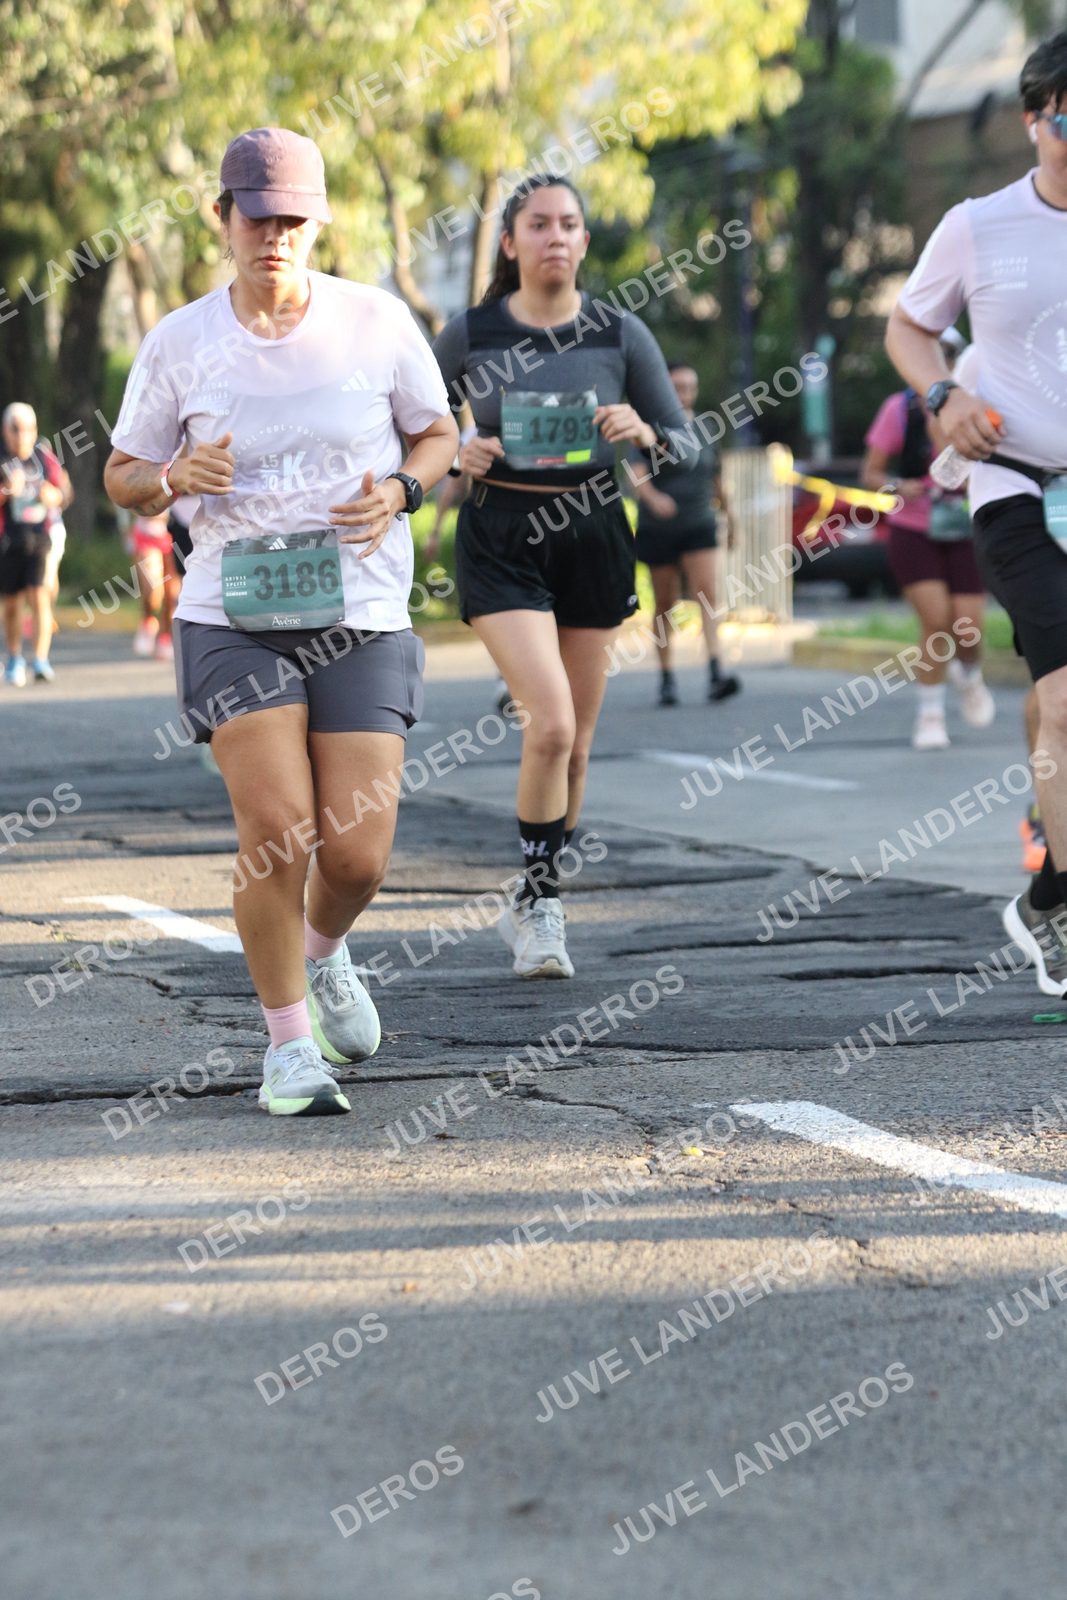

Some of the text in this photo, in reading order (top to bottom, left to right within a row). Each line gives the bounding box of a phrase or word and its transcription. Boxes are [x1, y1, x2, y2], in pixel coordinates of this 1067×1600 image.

[529, 415, 594, 444] 1793
[259, 454, 279, 469] 15
[282, 450, 307, 492] K
[254, 559, 339, 601] 3186
